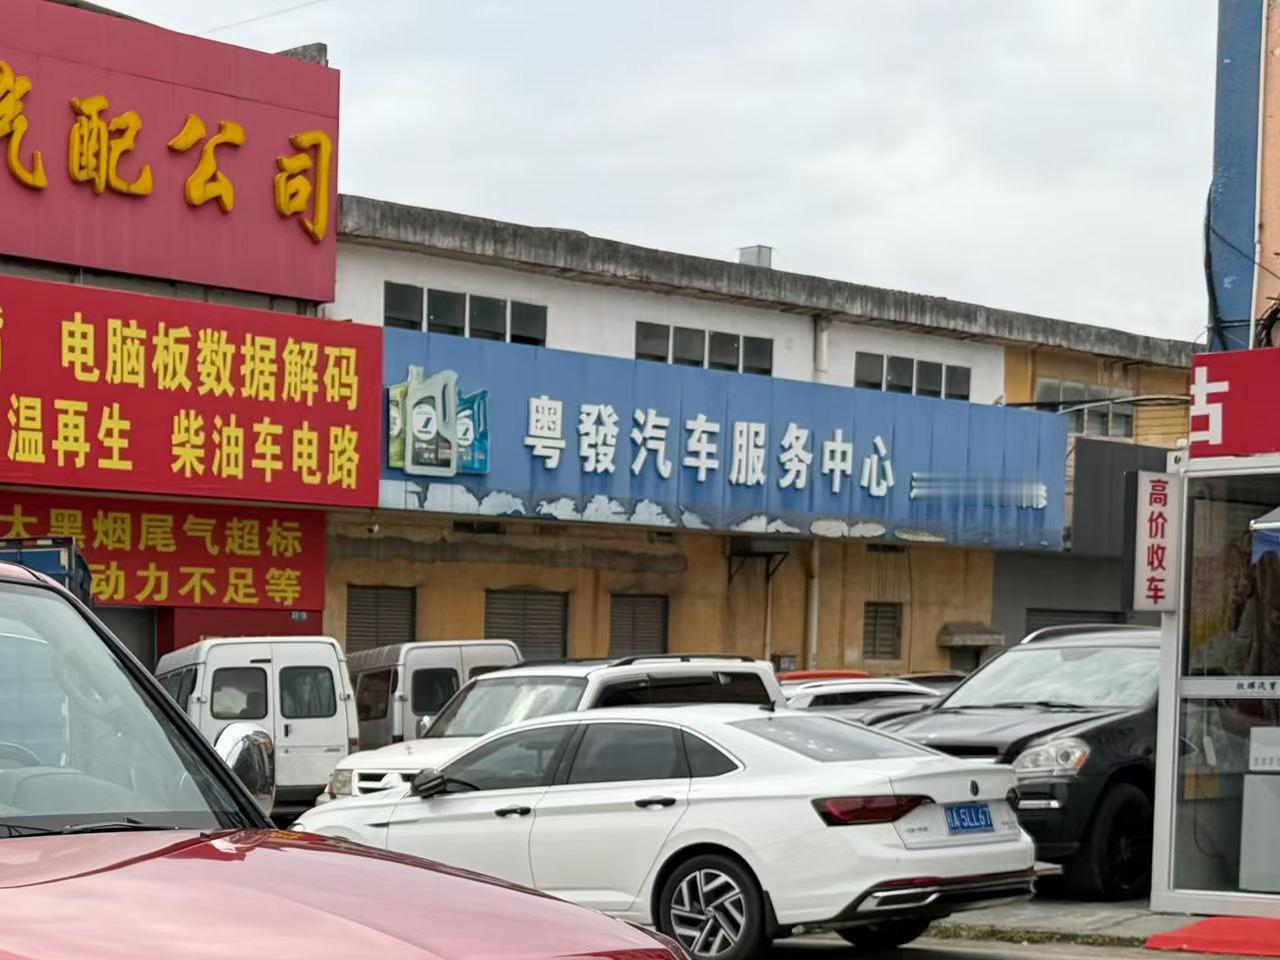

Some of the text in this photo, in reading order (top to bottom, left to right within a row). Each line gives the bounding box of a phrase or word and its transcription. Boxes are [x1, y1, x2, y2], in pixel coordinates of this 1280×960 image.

[60, 310, 360, 411] 电脑板数据解码
[171, 413, 360, 490] 柴油车电路
[524, 395, 894, 499] 粤發汽车服务中心
[1146, 479, 1168, 605] 高价收车
